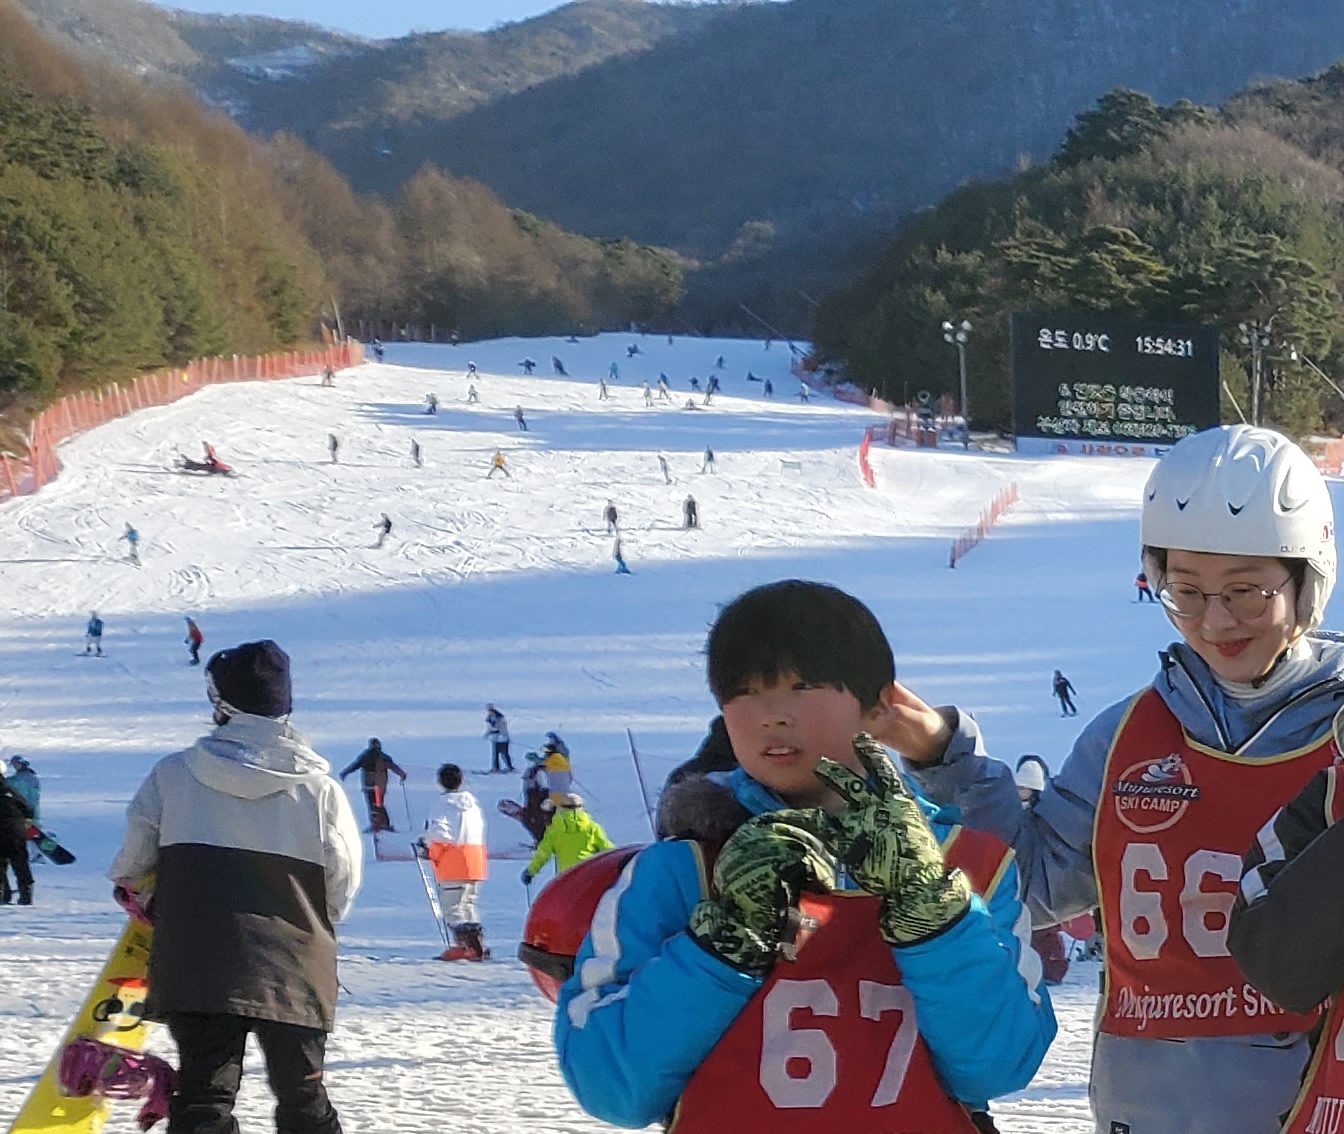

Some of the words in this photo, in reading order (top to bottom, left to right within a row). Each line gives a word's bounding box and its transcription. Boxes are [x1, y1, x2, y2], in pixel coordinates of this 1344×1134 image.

[1135, 336, 1194, 357] 15:54:31
[1120, 796, 1139, 810] SKI
[1141, 797, 1180, 813] CAMP
[1120, 843, 1243, 960] 66
[1115, 984, 1238, 1030] Mujuresort
[759, 978, 919, 1109] 67
